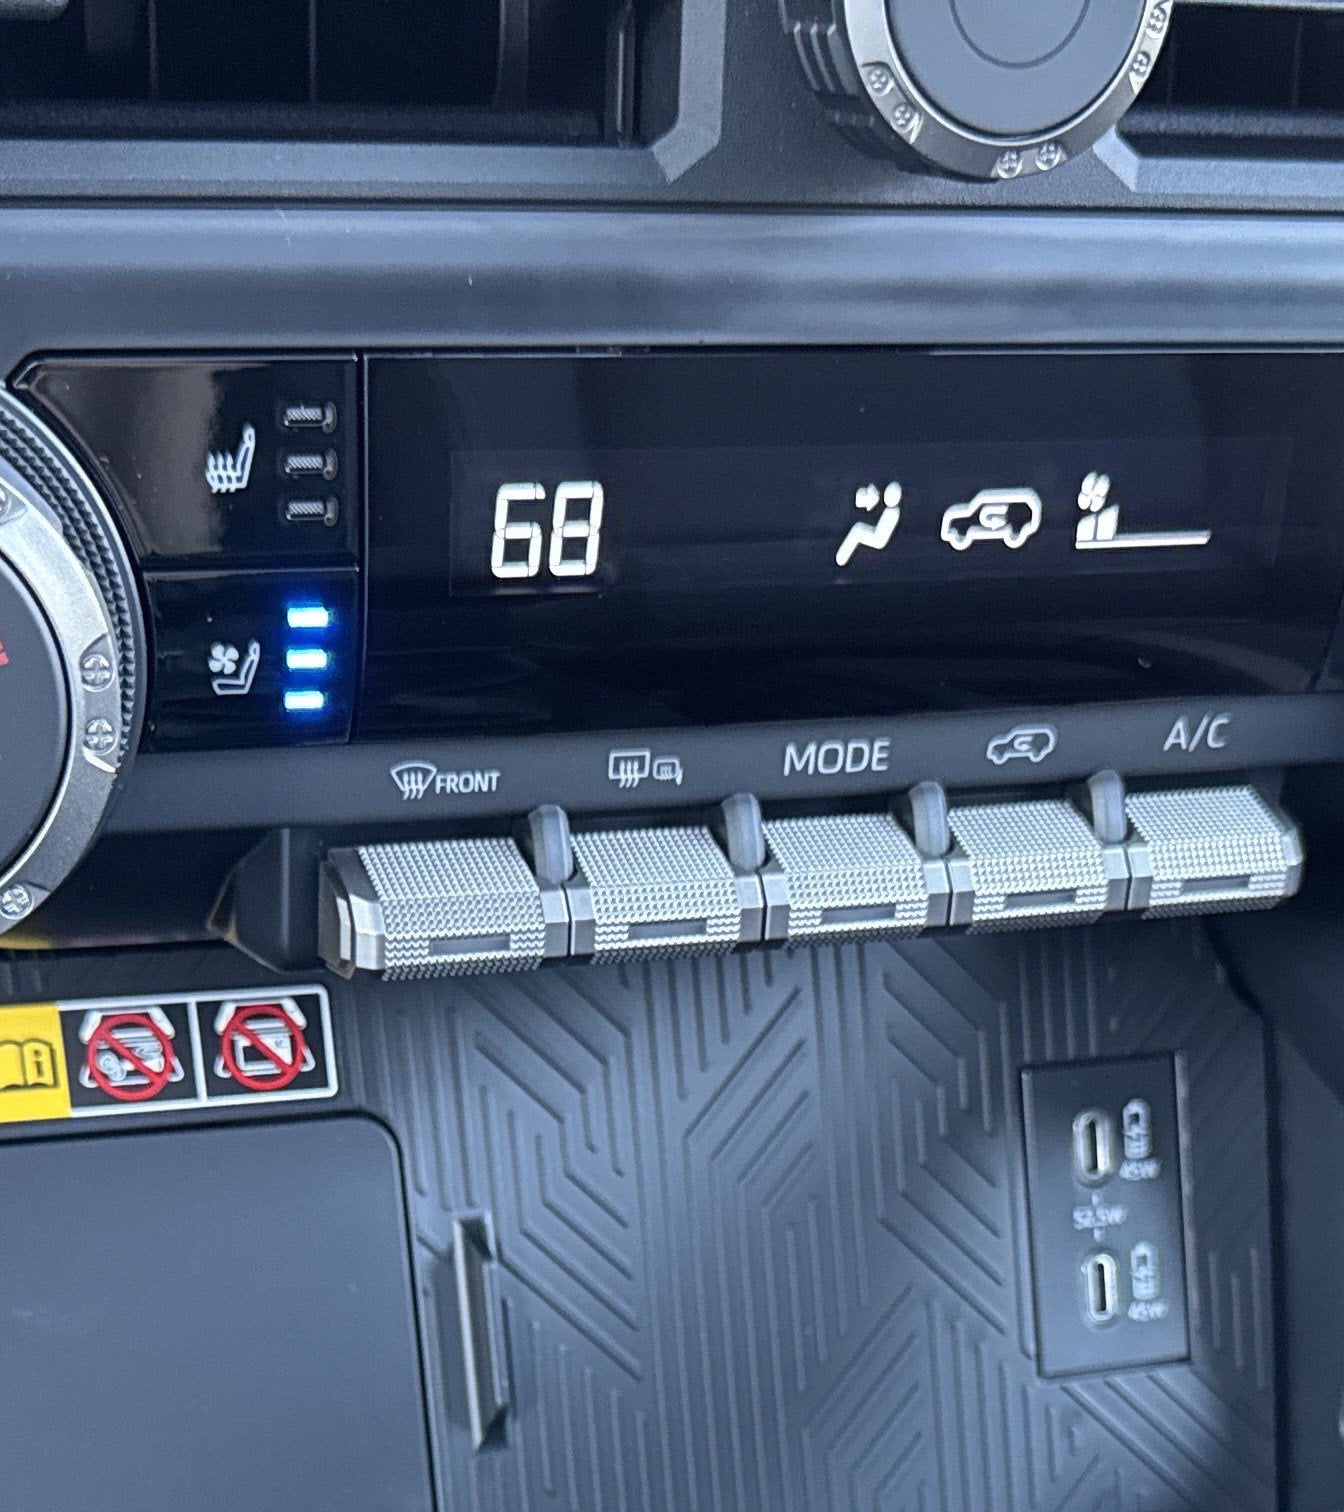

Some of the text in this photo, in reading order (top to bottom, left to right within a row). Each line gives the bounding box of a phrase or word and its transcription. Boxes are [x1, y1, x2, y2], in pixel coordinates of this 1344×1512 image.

[490, 481, 604, 579] 68
[1163, 714, 1231, 752] A/C
[783, 740, 891, 776] MODE
[435, 770, 501, 794] FRONT
